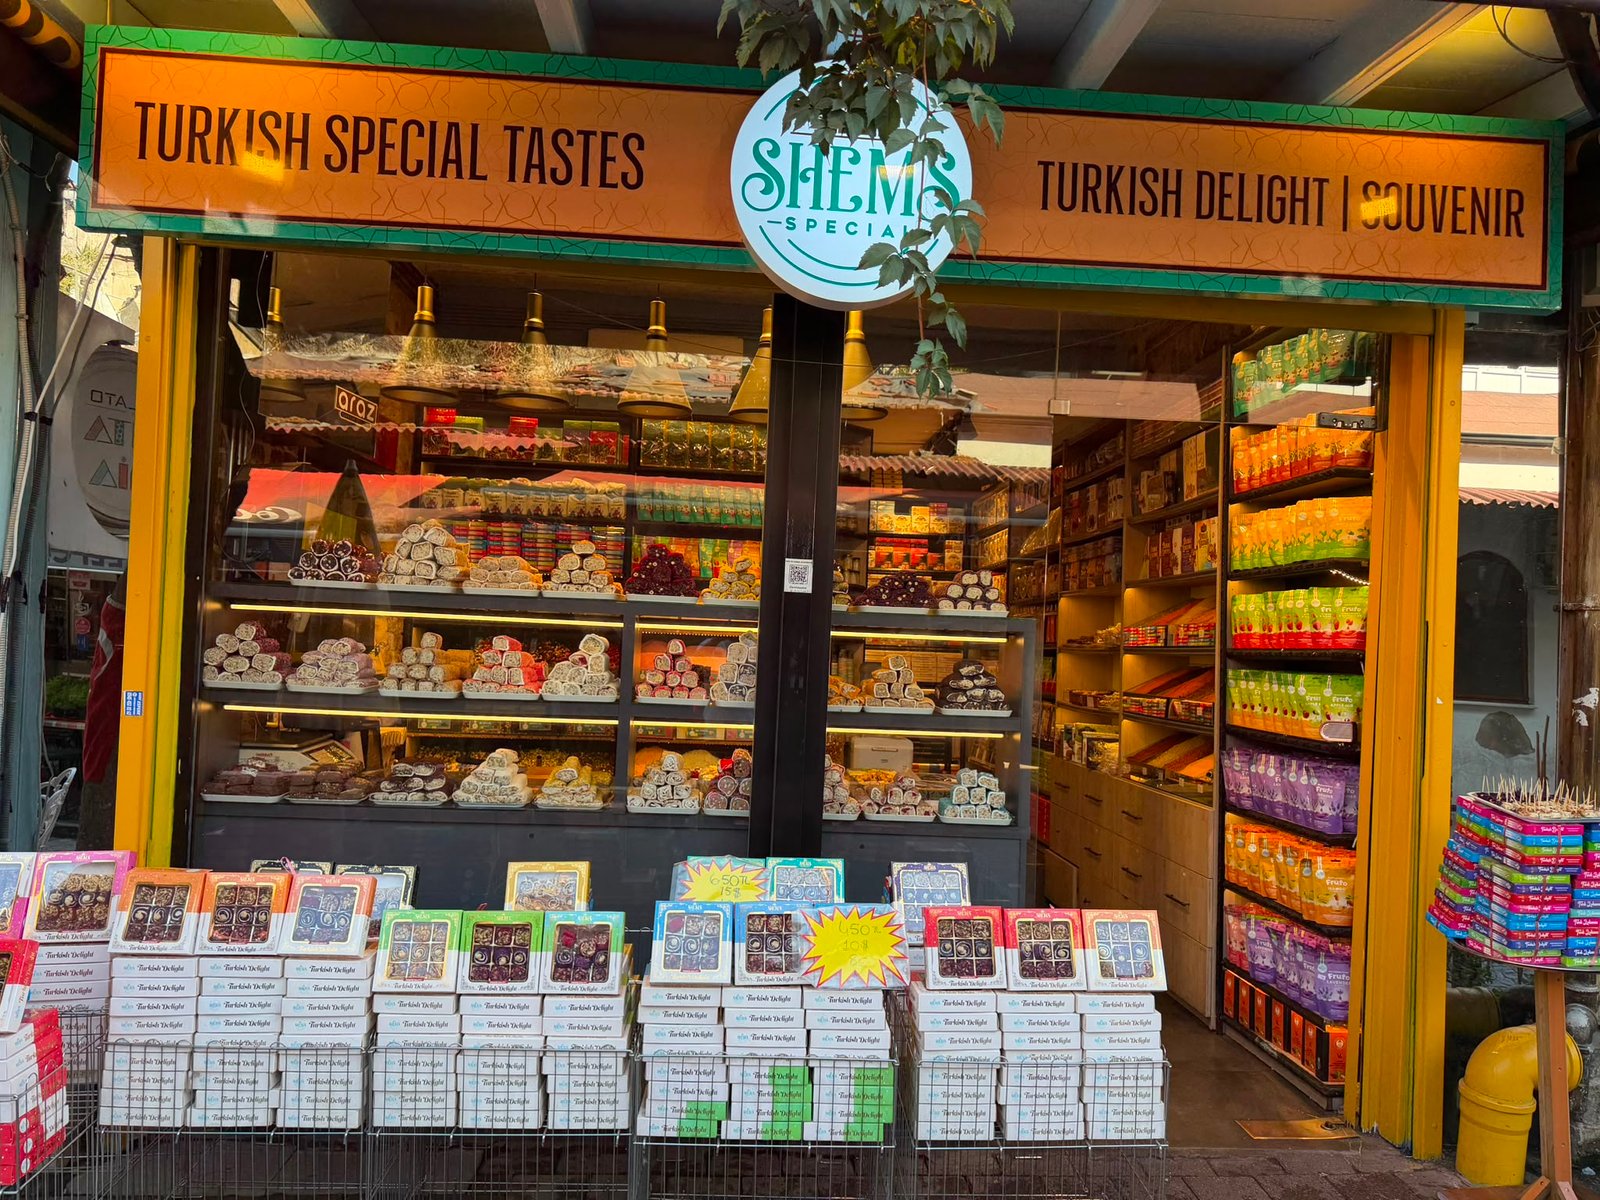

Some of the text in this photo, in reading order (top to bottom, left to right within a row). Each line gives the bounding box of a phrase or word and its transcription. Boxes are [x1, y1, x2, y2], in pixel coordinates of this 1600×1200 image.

[134, 101, 646, 190] TURKISH SPECIAL TASTES
[741, 137, 960, 221] SHEMS
[1038, 160, 1526, 239] TURKISH DELIGHT SOUVENIR
[338, 391, 375, 422] araz
[248, 964, 270, 972] Delight
[69, 969, 93, 977] Delight
[68, 987, 92, 995] Delight
[162, 984, 185, 992] Delight
[689, 993, 710, 1001] Delight
[769, 994, 791, 1002] Delight
[851, 996, 872, 1004] Delight
[420, 1001, 442, 1009] Delight
[507, 1002, 529, 1010] Delight
[686, 1011, 707, 1019] Delight
[160, 1021, 183, 1029] Delight
[510, 1021, 531, 1029] Delight
[1130, 1019, 1151, 1027] Delight
[773, 1034, 795, 1042] Delight
[858, 1036, 880, 1044] Delight
